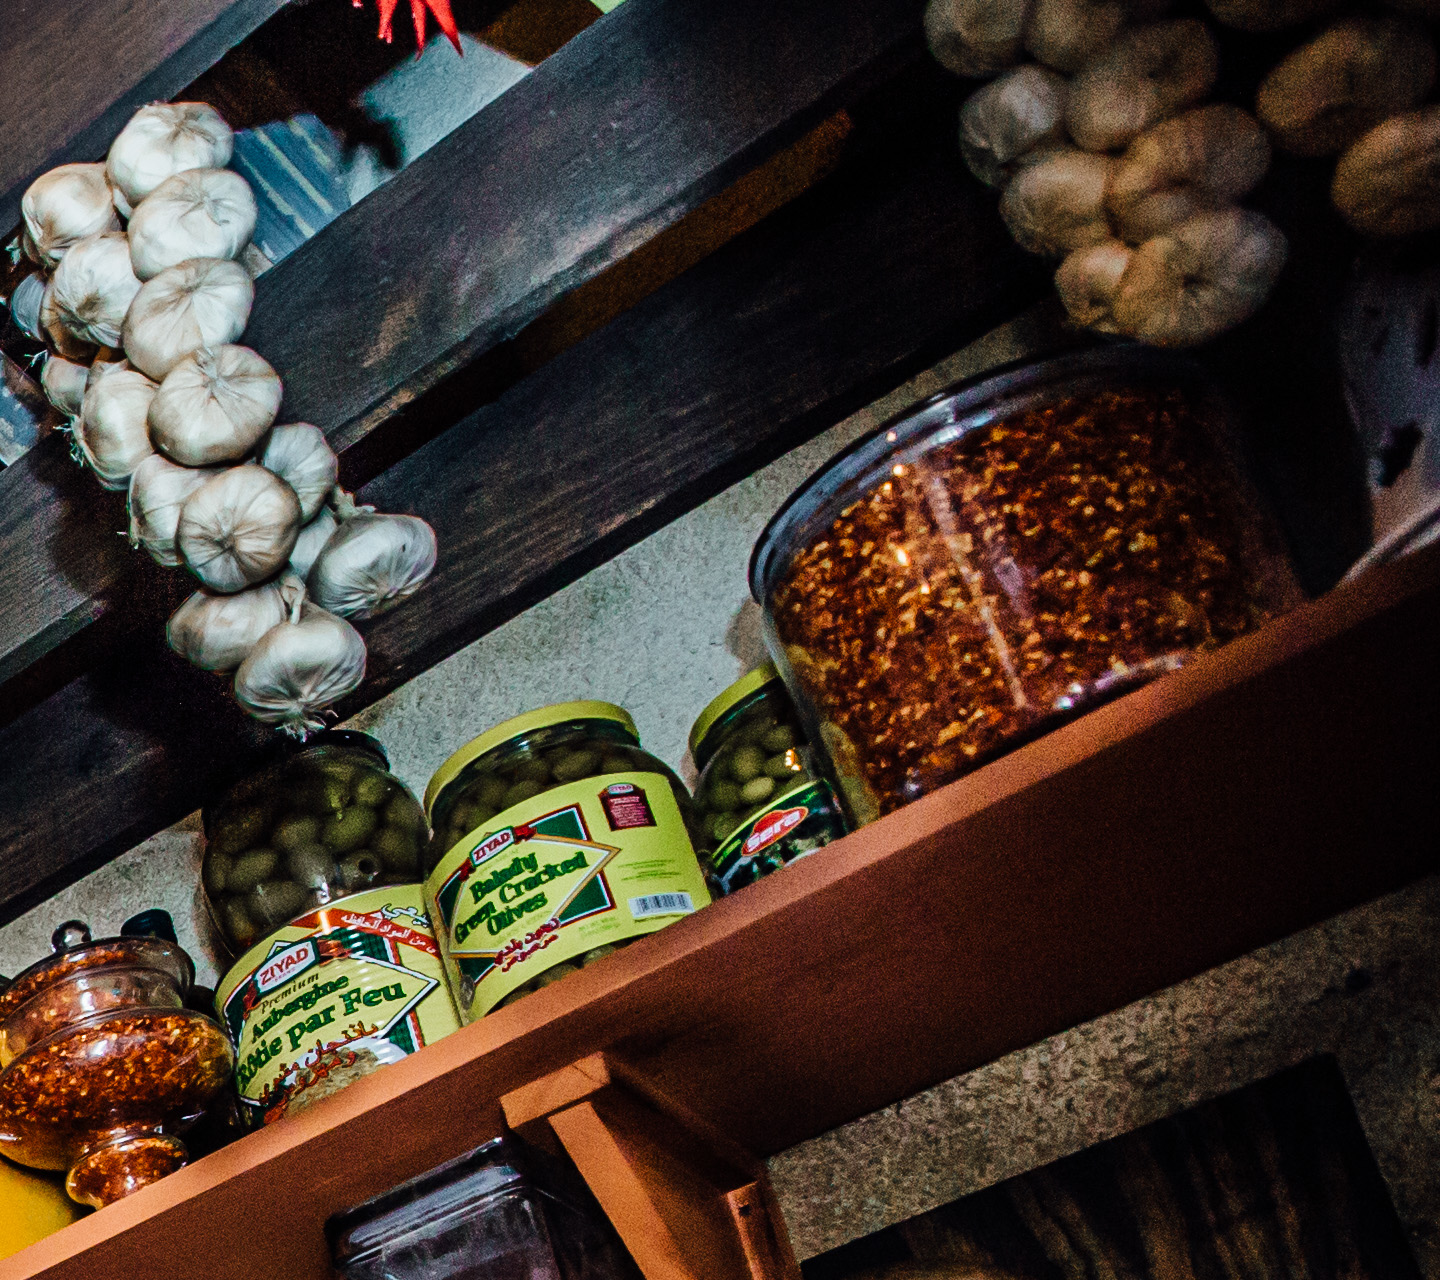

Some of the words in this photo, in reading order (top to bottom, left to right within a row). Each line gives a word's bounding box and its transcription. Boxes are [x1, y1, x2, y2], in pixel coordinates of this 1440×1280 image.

[473, 832, 511, 861] ZIYAD
[455, 901, 497, 944] Green
[499, 851, 590, 903] Cracked
[469, 852, 539, 904] Balady
[487, 892, 548, 936] Olives
[260, 946, 309, 986] ZIYAD
[251, 976, 349, 1043] Aubergine
[261, 972, 320, 1014] Premium
[286, 1005, 336, 1052] par
[339, 982, 406, 1016] Feu
